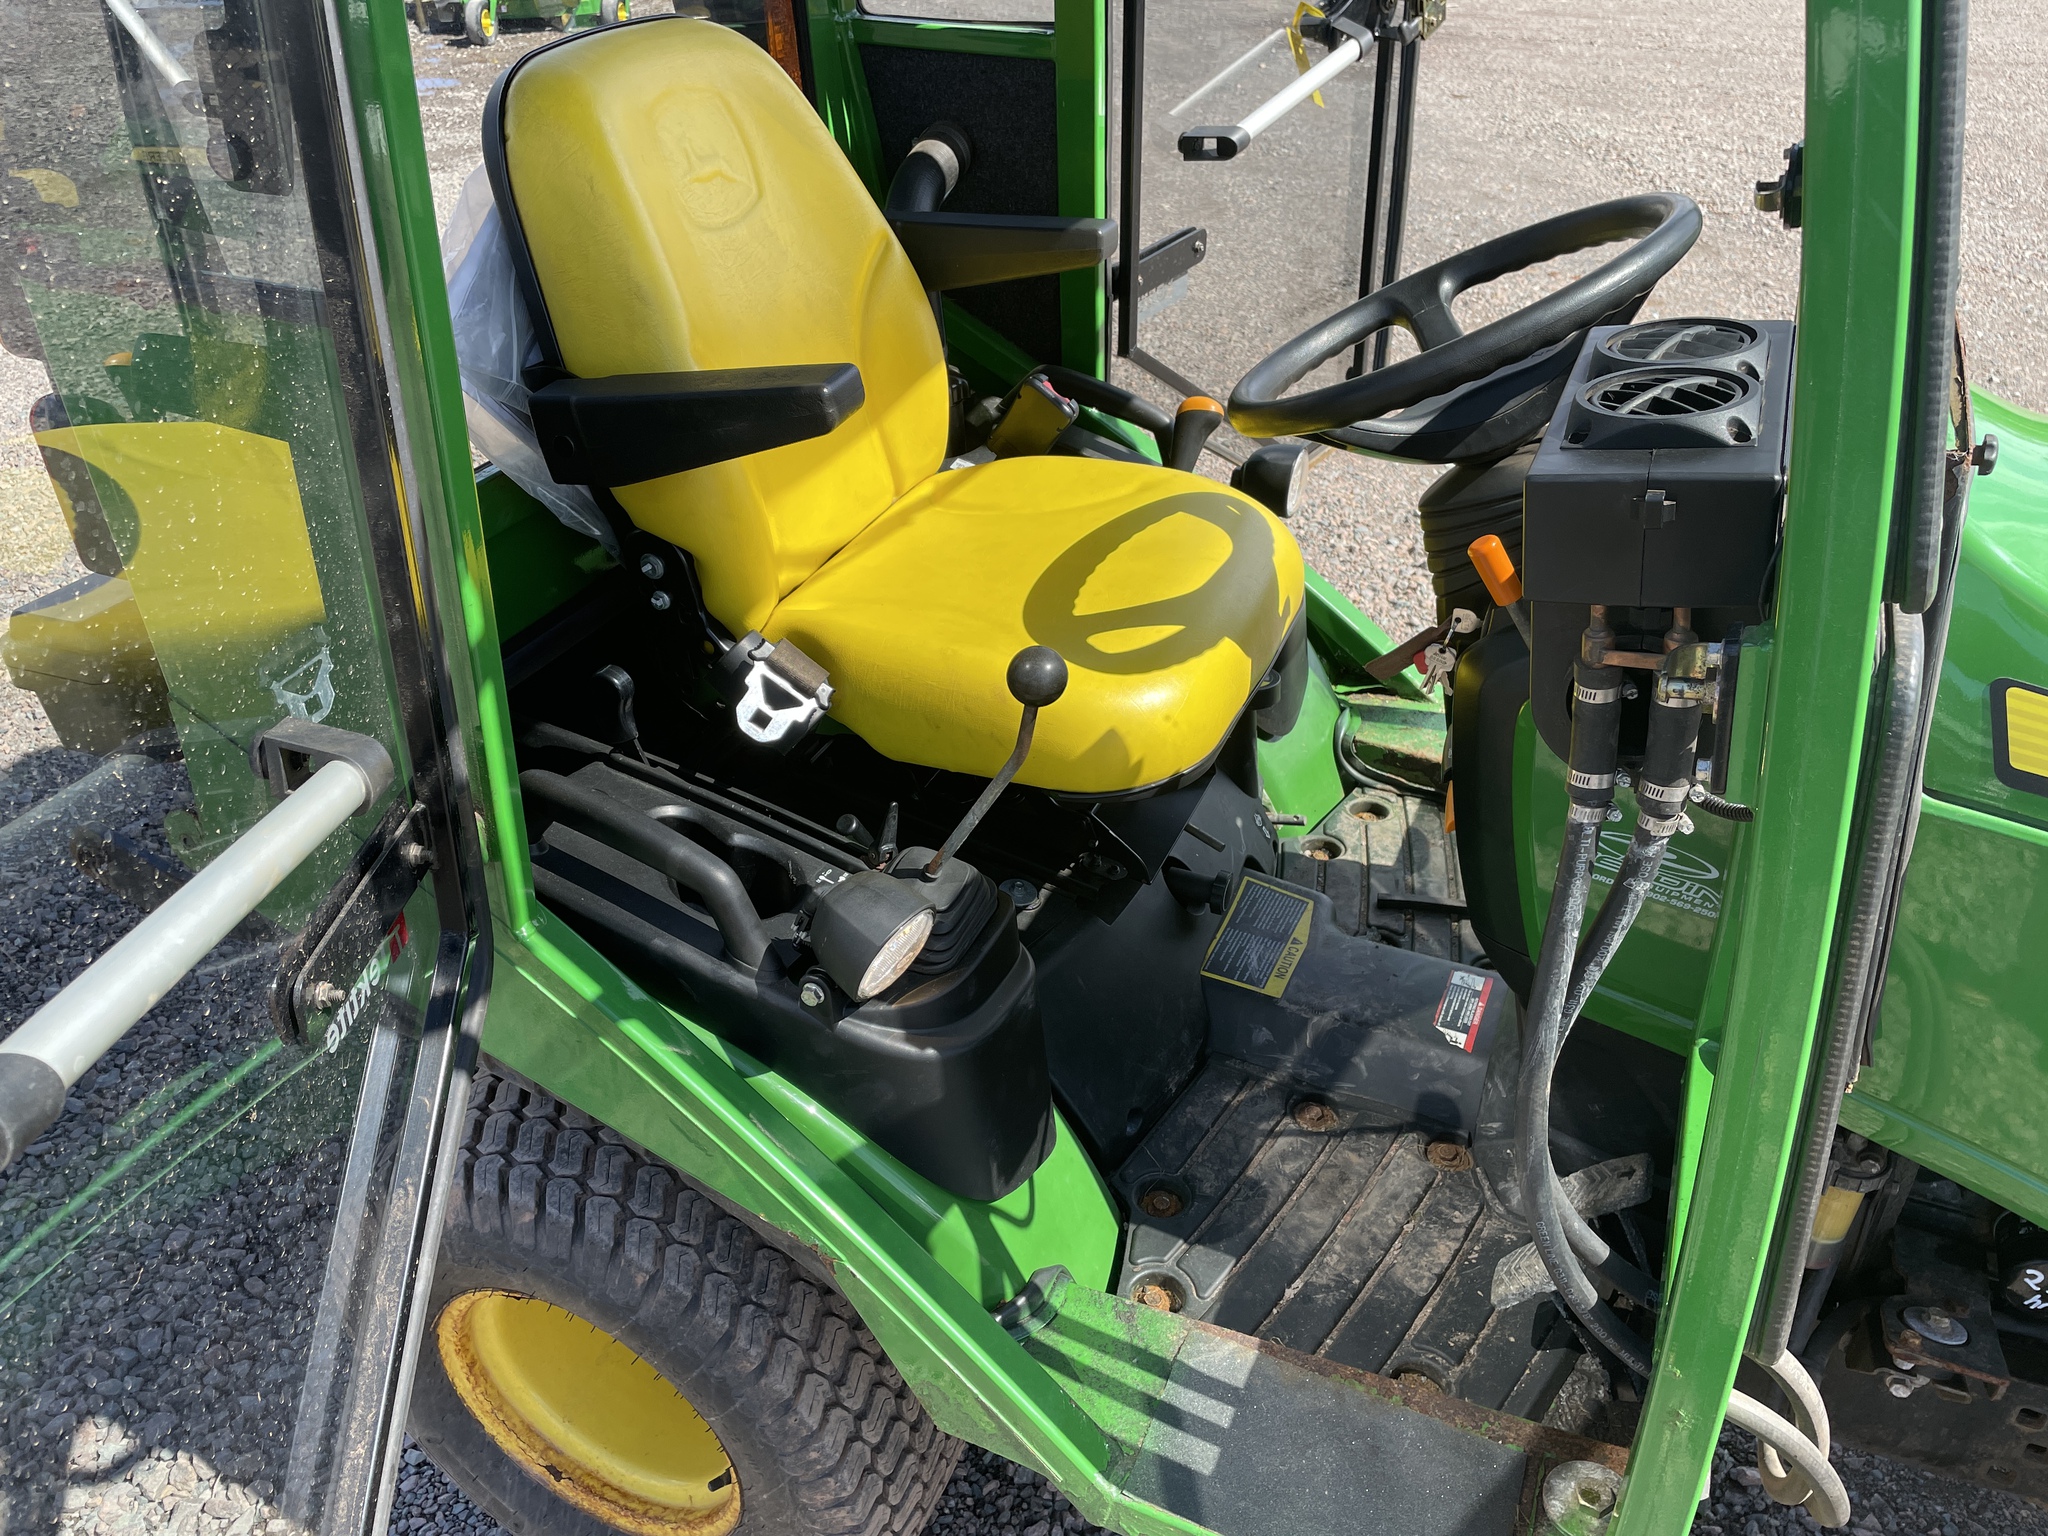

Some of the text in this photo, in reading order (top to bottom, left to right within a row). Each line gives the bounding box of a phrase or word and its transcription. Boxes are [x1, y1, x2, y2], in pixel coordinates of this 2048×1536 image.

[1274, 946, 1301, 980] CAUTION
[1473, 1006, 1484, 1025] DANGER
[1535, 1221, 1550, 1247] GREEN
